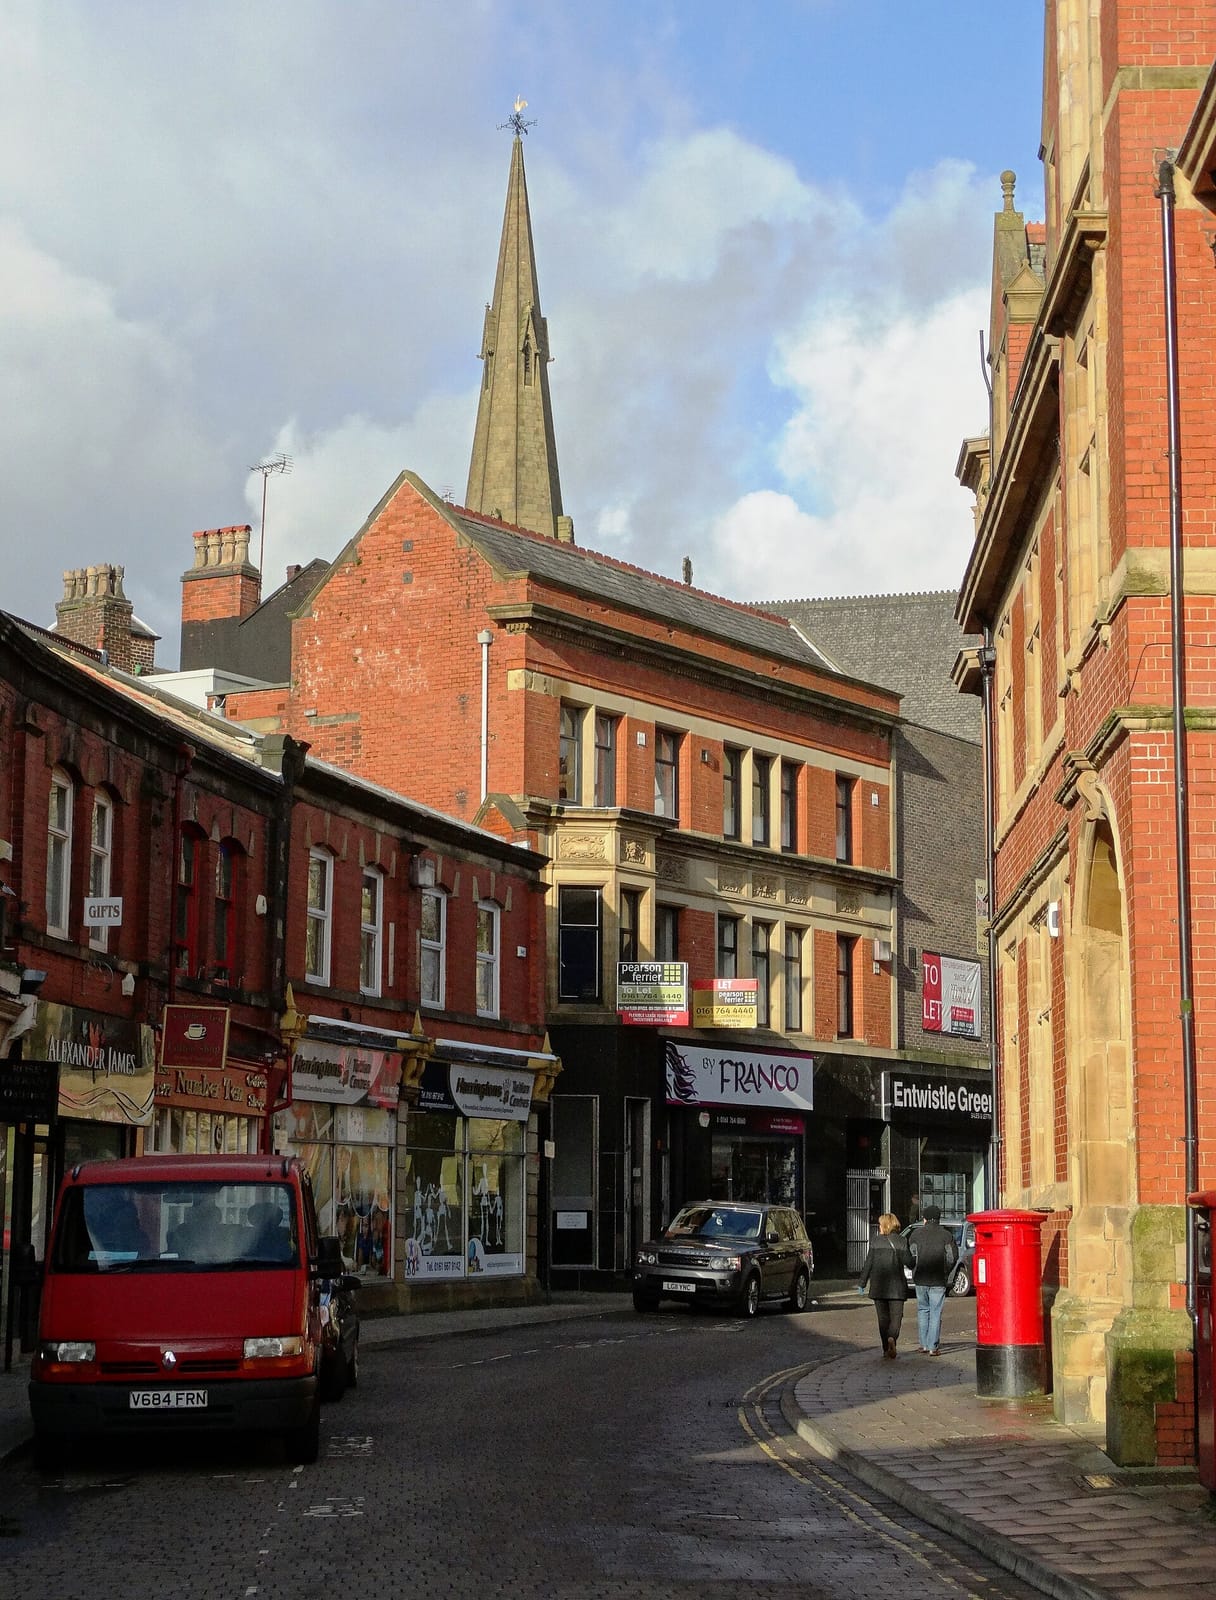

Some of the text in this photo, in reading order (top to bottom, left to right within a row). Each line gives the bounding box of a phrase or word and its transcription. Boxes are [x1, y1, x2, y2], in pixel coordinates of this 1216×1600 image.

[89, 905, 120, 918] GIFTS
[622, 964, 661, 974] pearson
[632, 972, 662, 982] ferrier
[923, 964, 938, 985] TO
[718, 981, 732, 989] LET
[923, 999, 942, 1020] LET
[48, 1035, 136, 1076] ALEXANDER JAMES
[719, 1059, 799, 1093] FRANCO
[894, 1081, 956, 1110] Entwistle
[132, 1392, 207, 1406] V684 FRN
